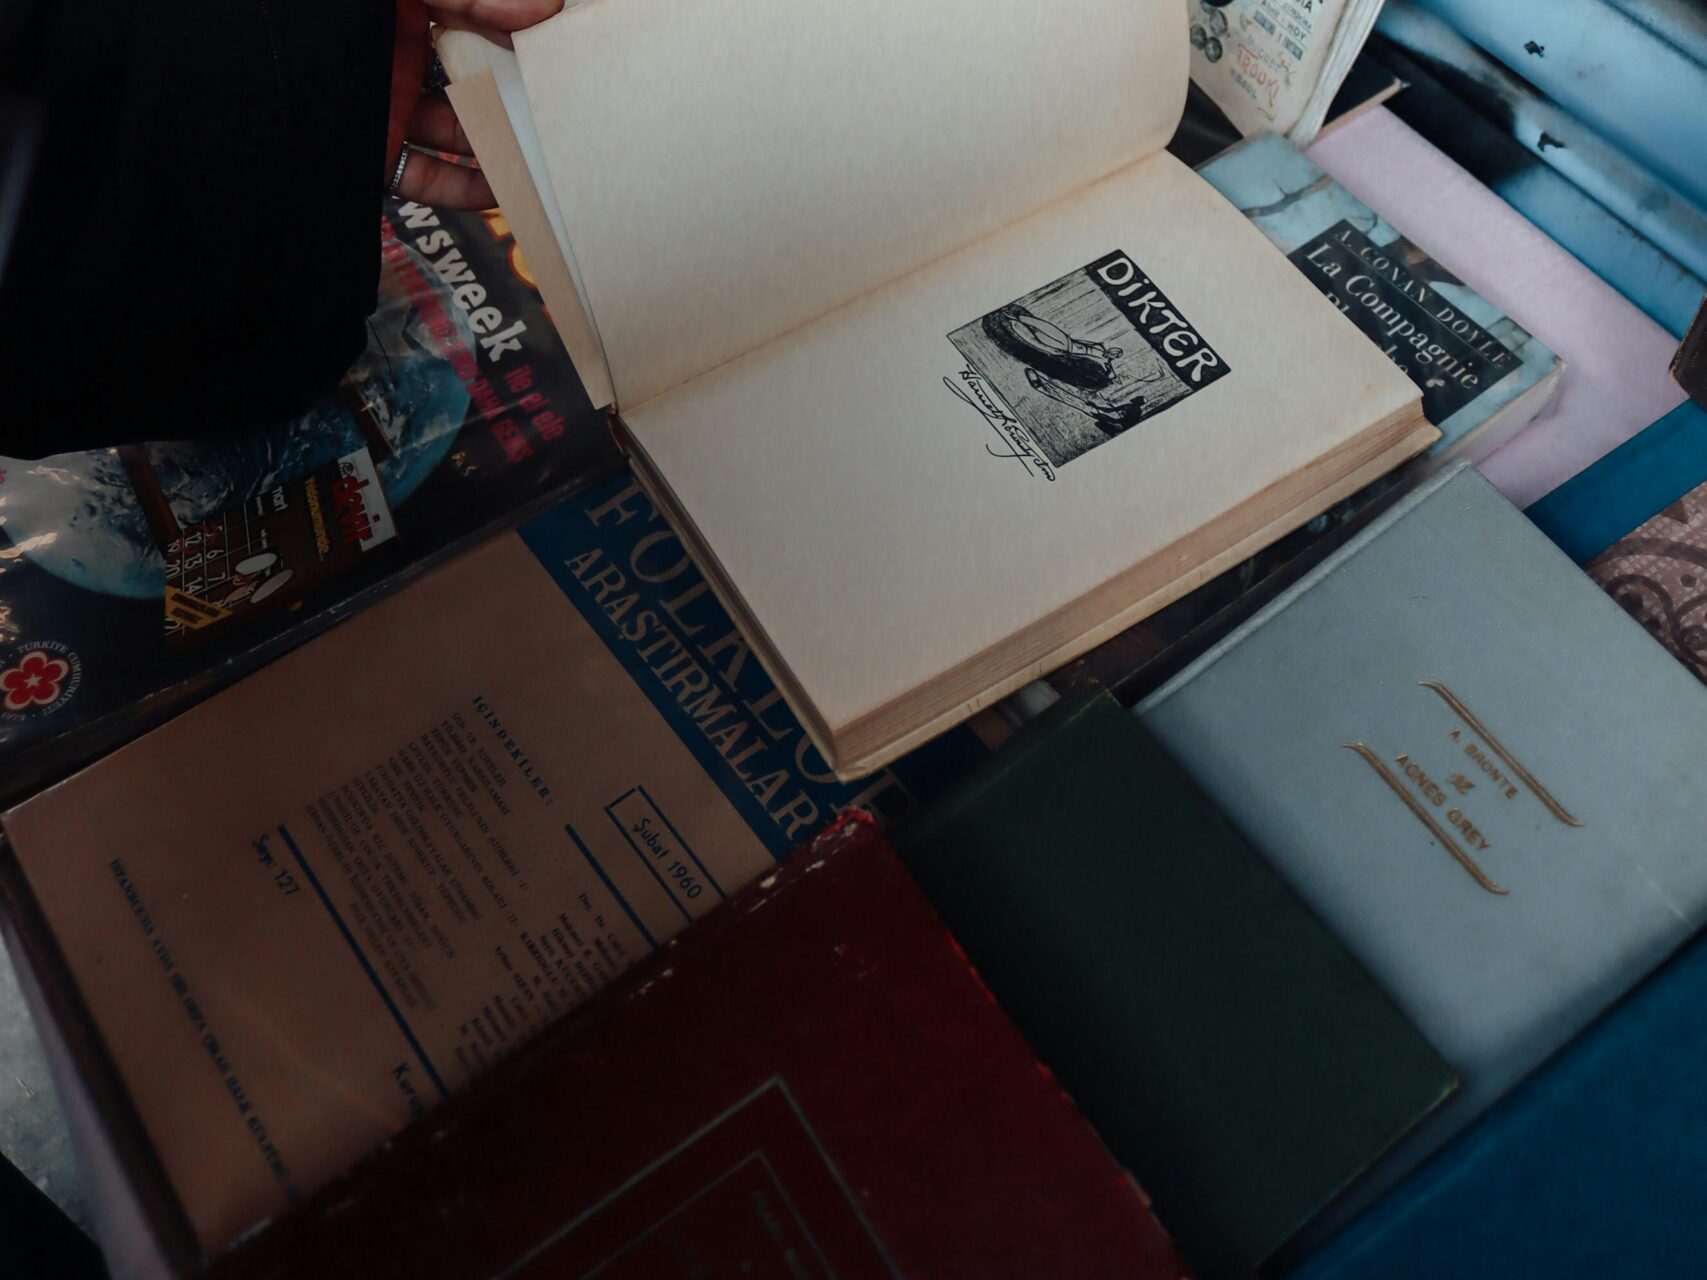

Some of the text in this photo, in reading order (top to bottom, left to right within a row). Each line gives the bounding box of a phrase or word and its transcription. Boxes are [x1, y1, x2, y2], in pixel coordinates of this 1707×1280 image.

[396, 199, 527, 363] wsweek
[1305, 243, 1343, 278] La
[1345, 274, 1480, 391] Compagnie
[1360, 247, 1432, 303] CONAN
[1436, 306, 1510, 368] DOYLE
[273, 870, 301, 897] 127
[632, 818, 702, 899] Şubat 1960
